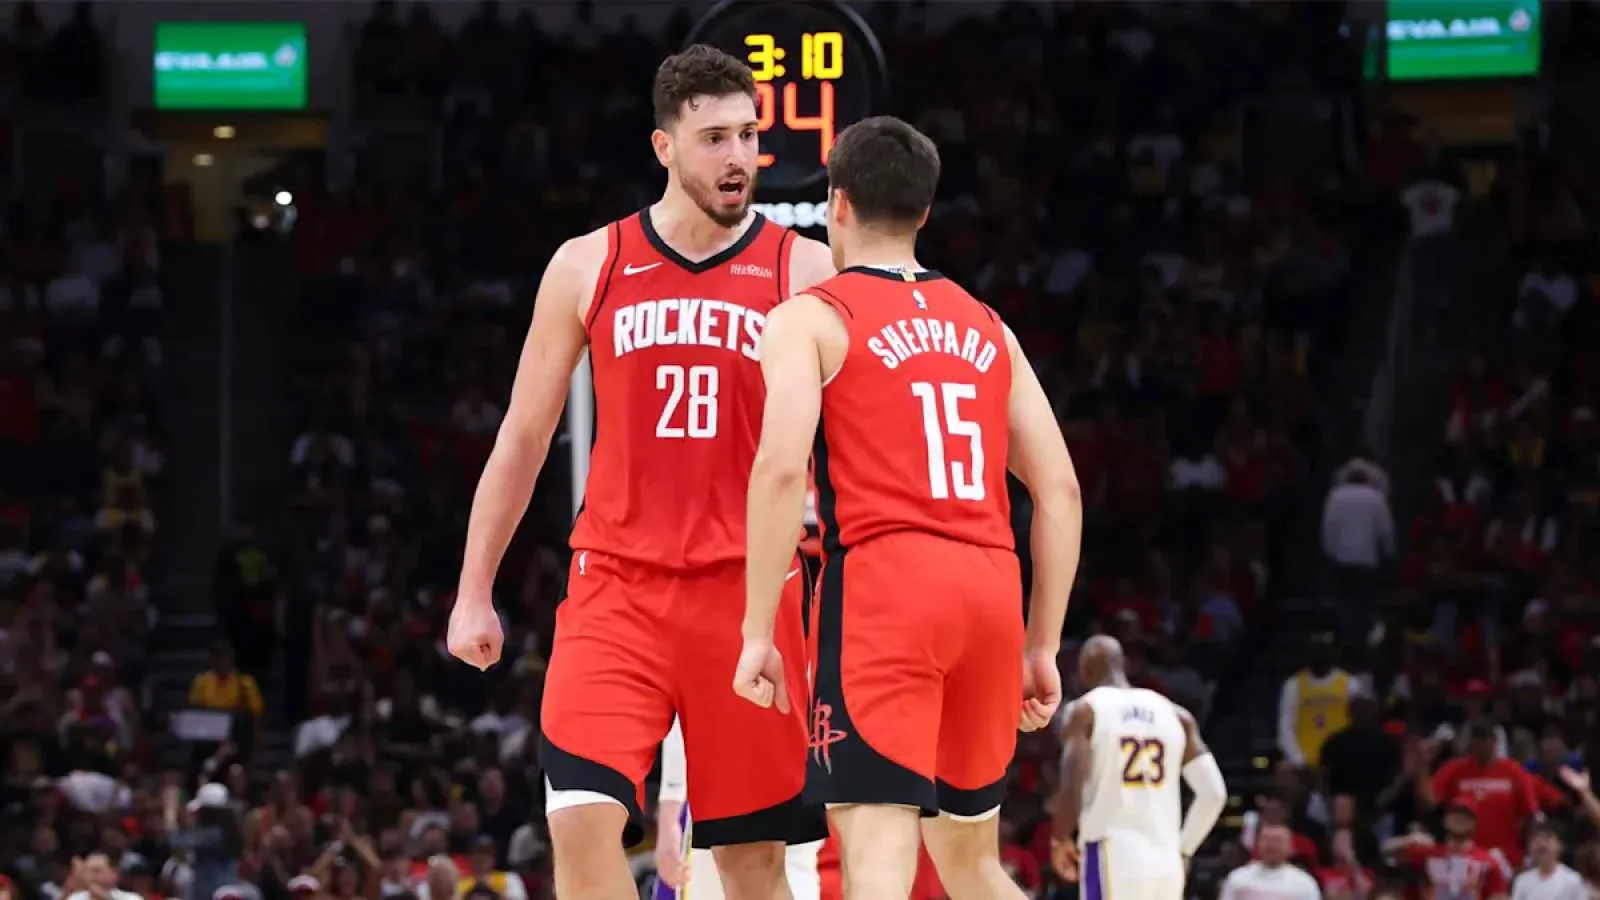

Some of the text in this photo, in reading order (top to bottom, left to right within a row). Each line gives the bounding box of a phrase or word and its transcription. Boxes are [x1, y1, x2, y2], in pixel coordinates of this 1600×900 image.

[613, 298, 769, 361] ROCKETS
[867, 318, 998, 373] SHEPPARD
[655, 365, 719, 439] 28
[911, 382, 986, 500] 15
[1119, 736, 1165, 788] 23
